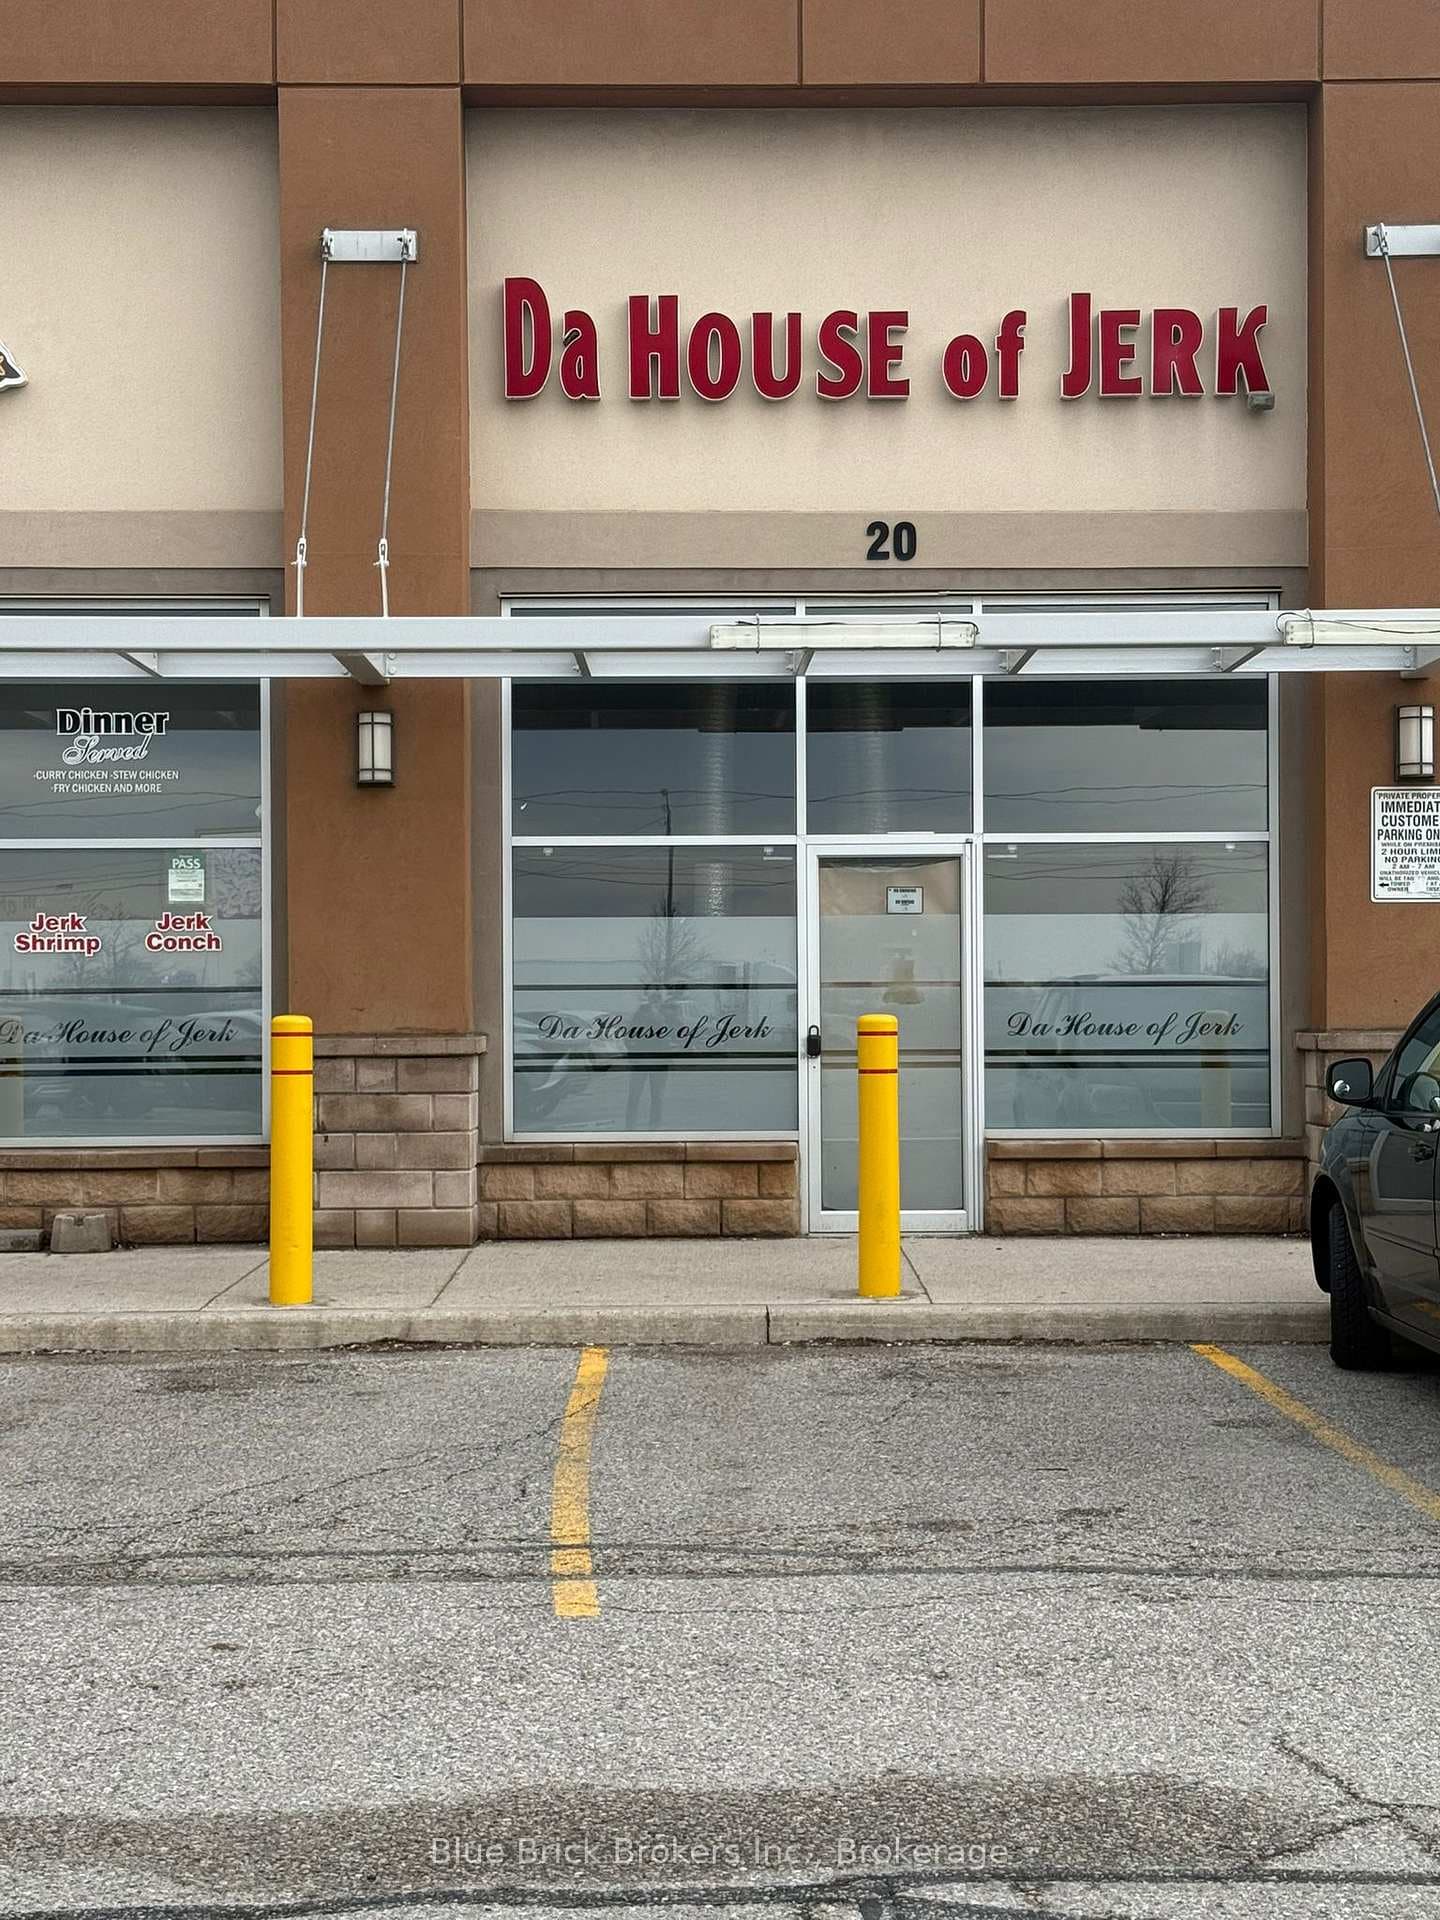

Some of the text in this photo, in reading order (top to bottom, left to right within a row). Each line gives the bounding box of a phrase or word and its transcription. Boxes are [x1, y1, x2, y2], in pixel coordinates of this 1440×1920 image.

[503, 276, 1271, 401] Da HOUSE of JERK
[865, 520, 917, 562] 20
[56, 708, 169, 736] Dinner
[62, 735, 151, 765] Served
[68, 770, 108, 780] CHICKEN
[139, 770, 179, 780] CHICKEN
[72, 783, 112, 793] CHICKEN
[113, 783, 133, 793] AND
[135, 783, 162, 793] MORE
[1378, 792, 1409, 800] PRIVATE
[1377, 829, 1422, 841] PARKING
[1381, 848, 1388, 856] 2
[1390, 848, 1418, 856] HOUR
[1384, 856, 1398, 864] NO
[172, 858, 201, 869] PASS
[31, 912, 87, 933] Jerk
[156, 911, 213, 932] Jerk
[15, 934, 101, 956] Shrimp
[145, 933, 222, 952] Conch
[0, 1016, 240, 1052] Da House of Jerk
[537, 1014, 775, 1049] Da House of Jerk
[1007, 1009, 1245, 1046] Da House of Jerk
